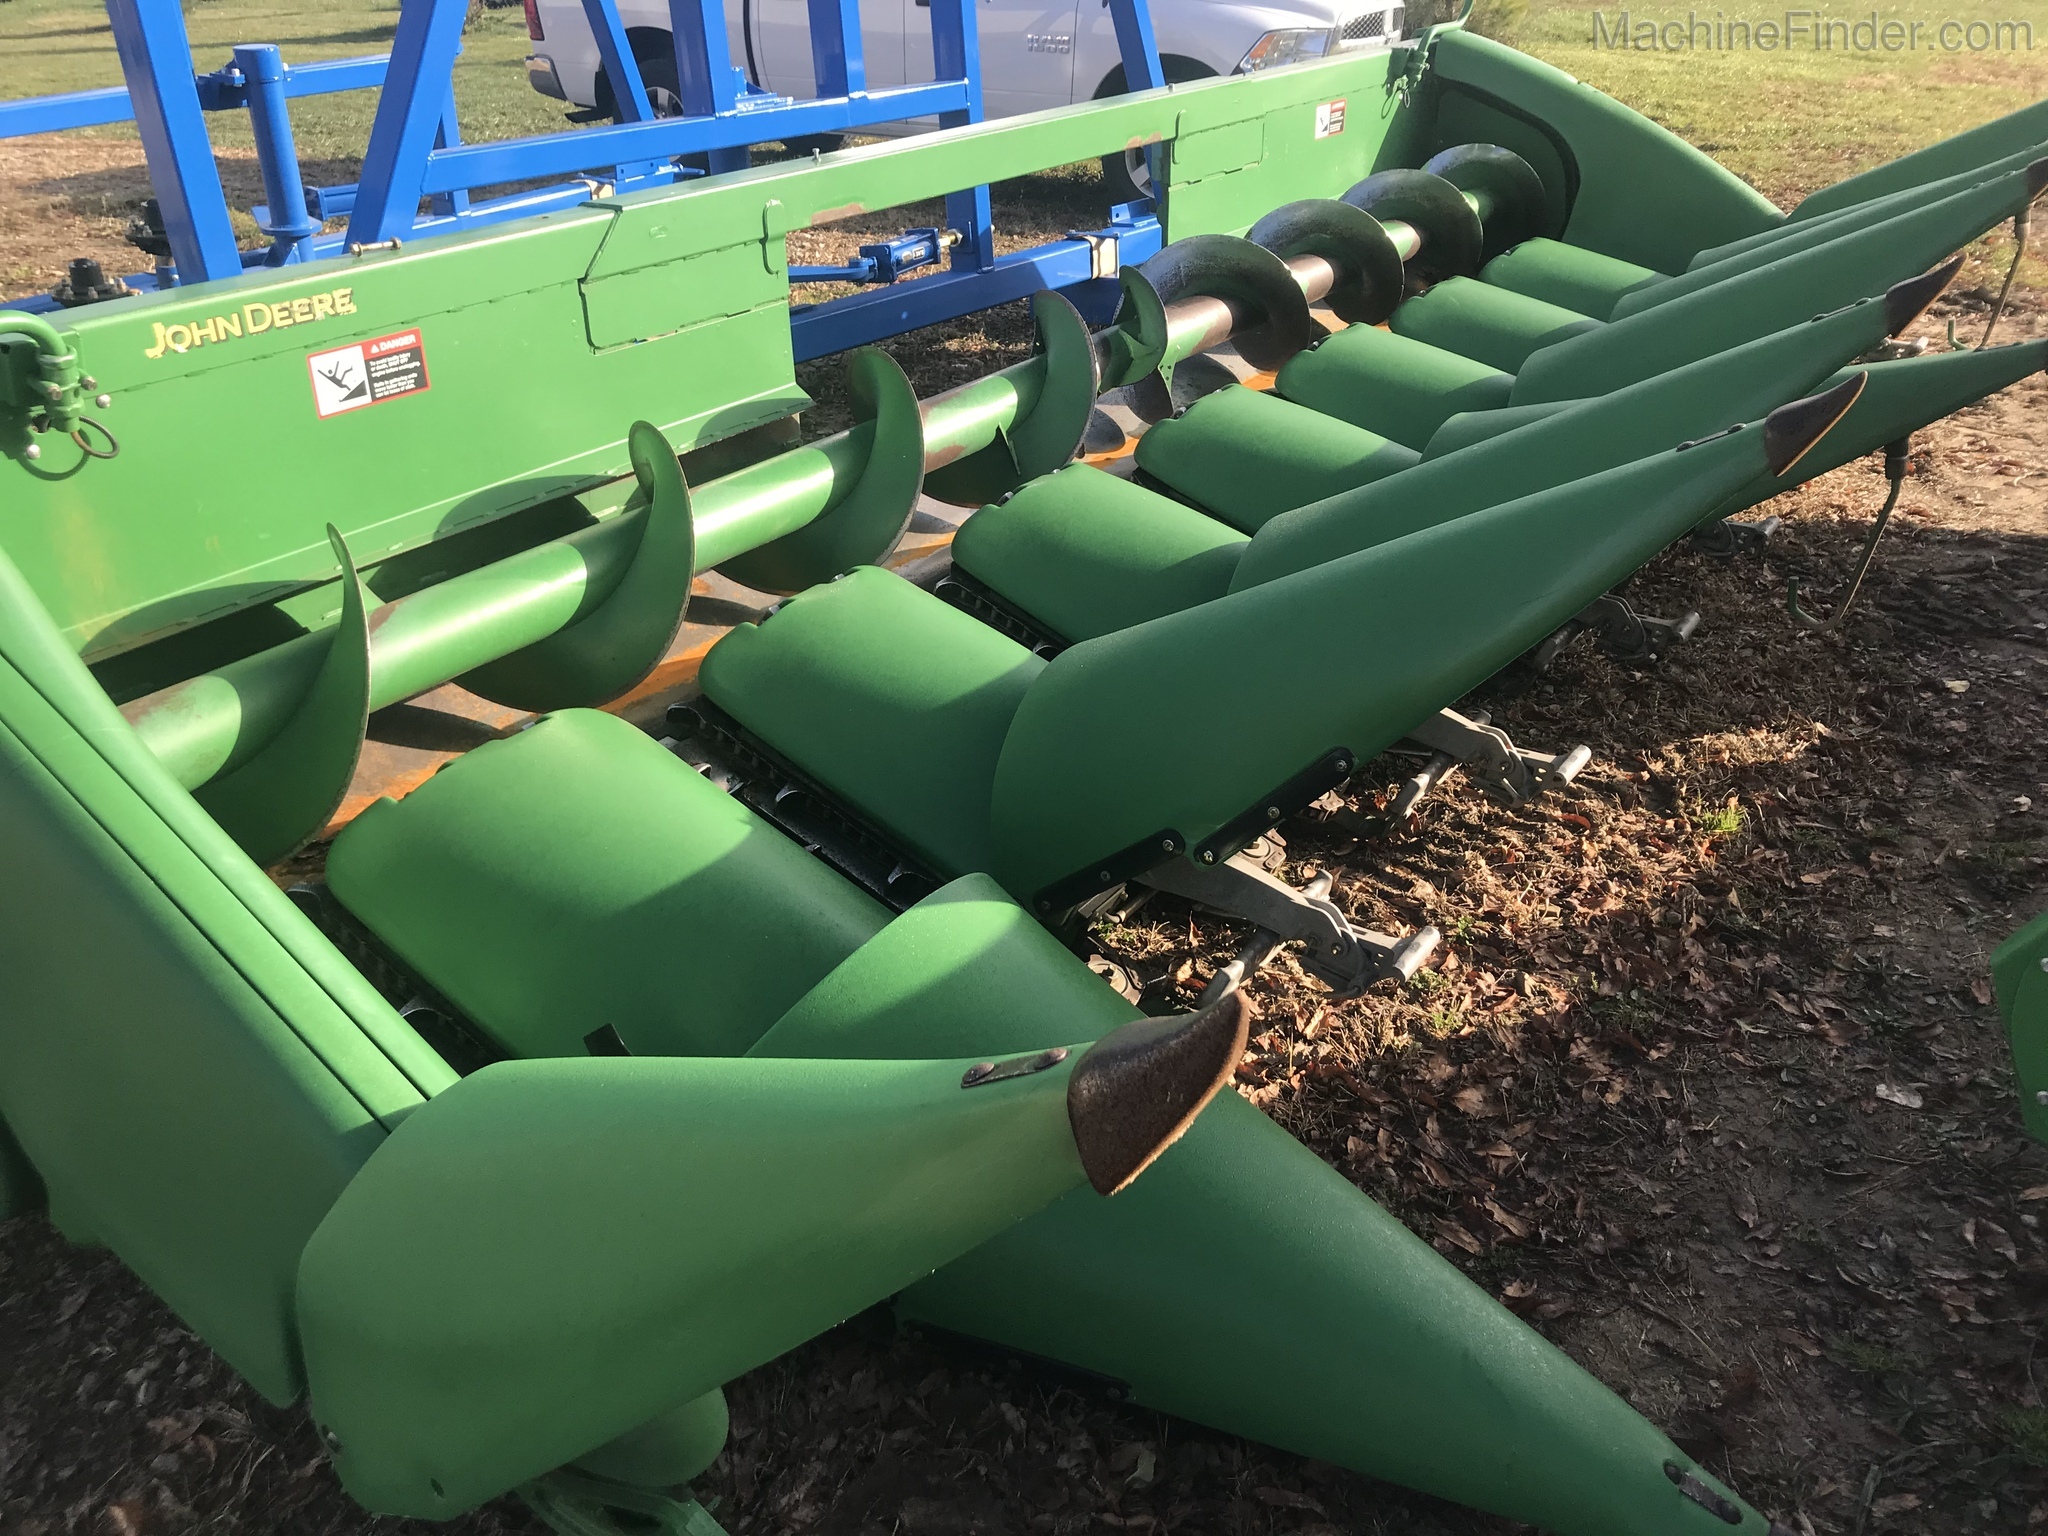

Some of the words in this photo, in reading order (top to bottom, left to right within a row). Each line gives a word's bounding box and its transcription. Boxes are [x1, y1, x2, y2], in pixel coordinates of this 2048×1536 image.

[145, 313, 243, 358] JOHN
[243, 288, 357, 335] DEERE
[379, 334, 416, 351] DANGER
